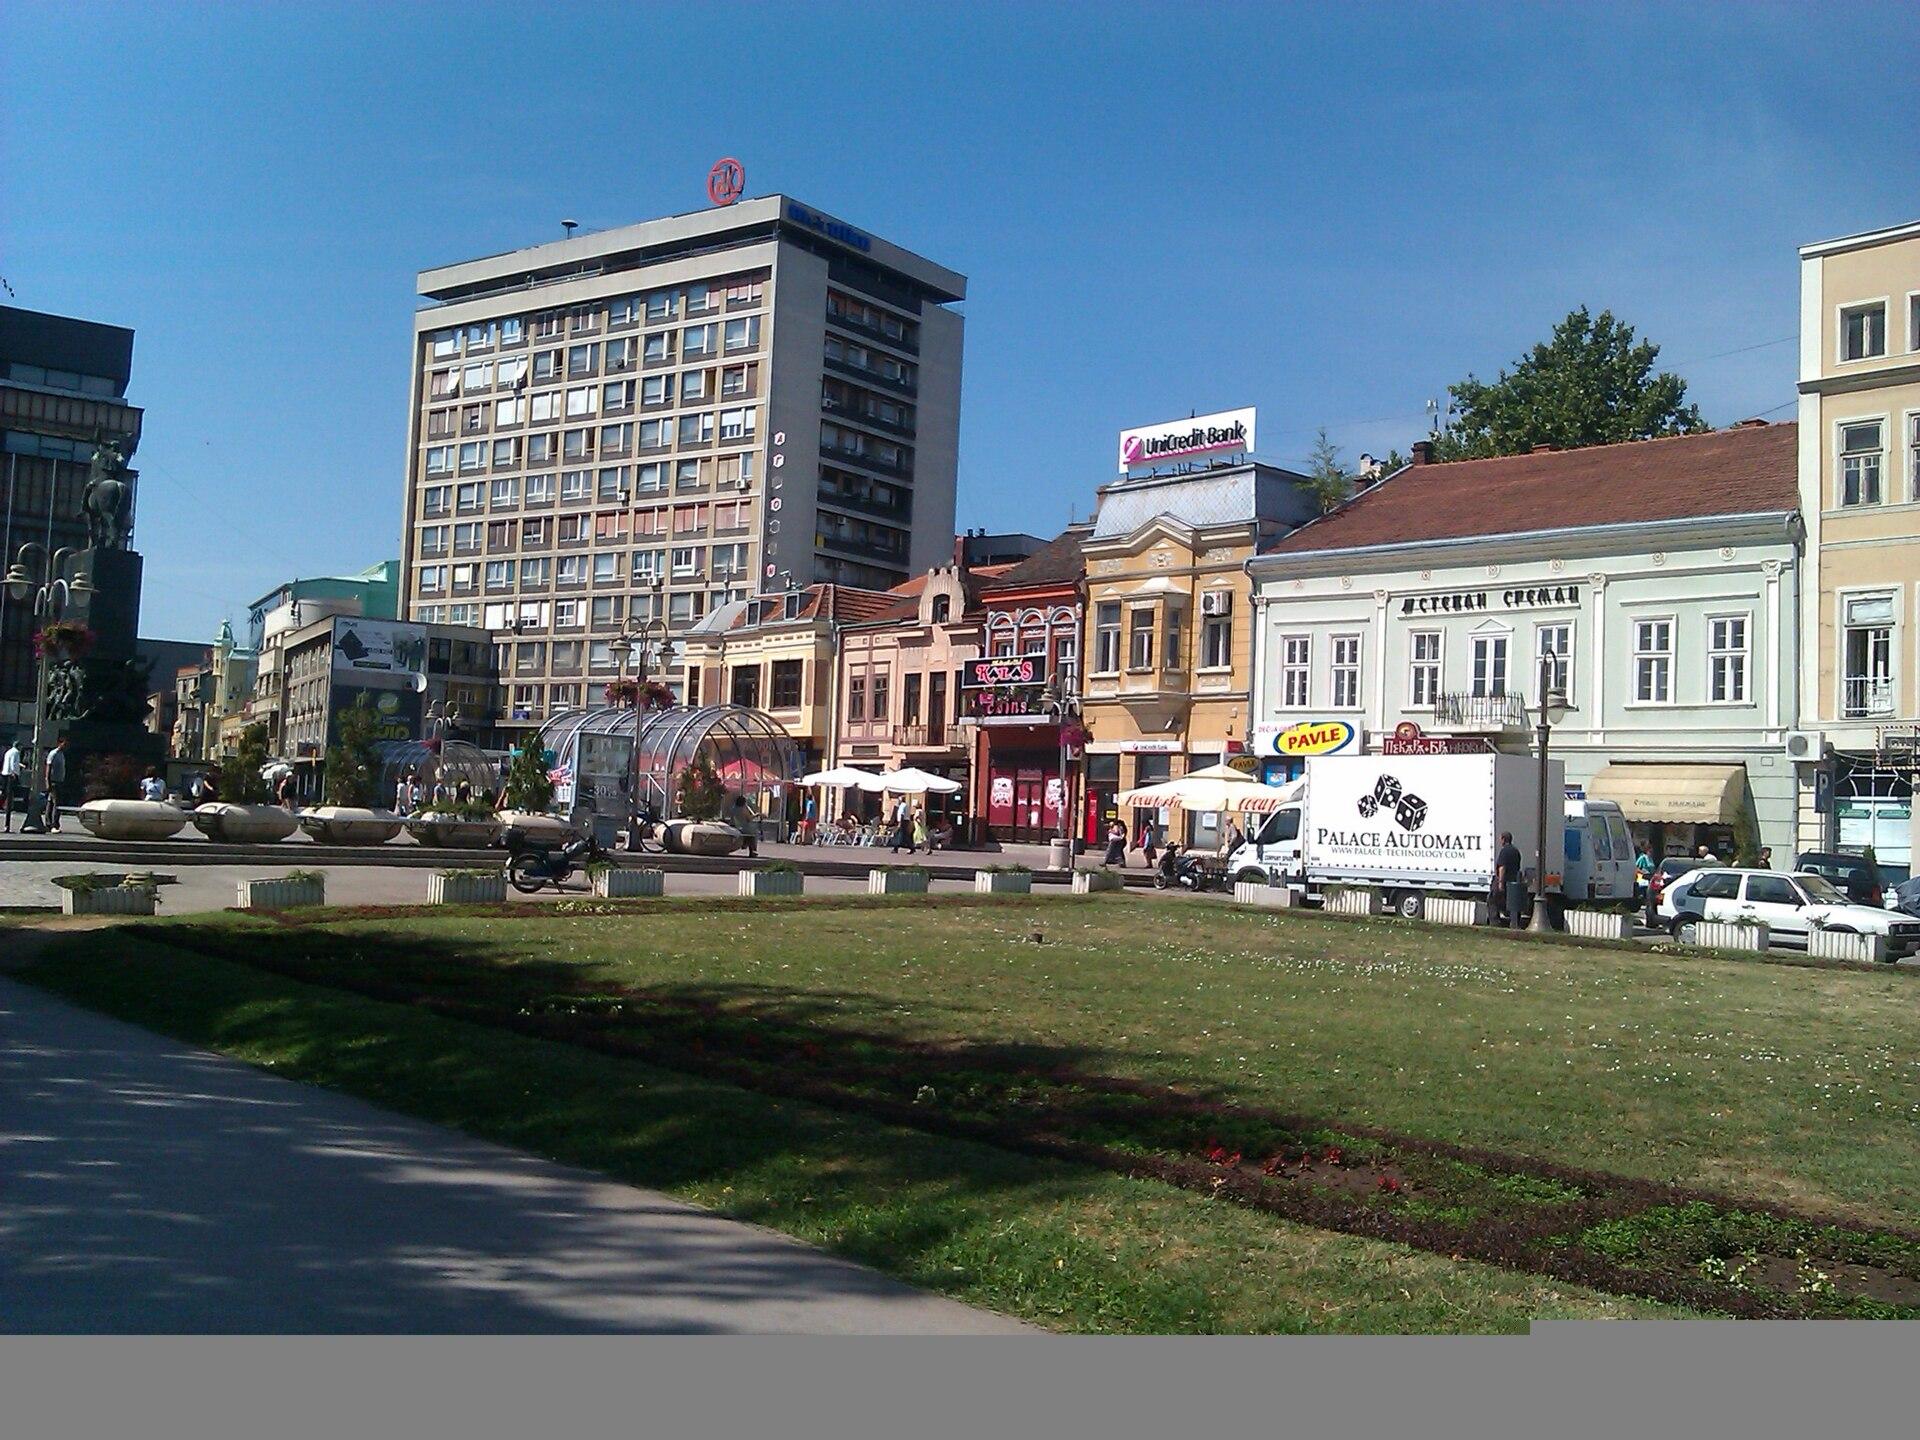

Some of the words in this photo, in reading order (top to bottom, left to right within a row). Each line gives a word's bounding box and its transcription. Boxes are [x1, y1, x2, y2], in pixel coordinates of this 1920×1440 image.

[1146, 426, 1206, 455] UniCredit
[1207, 420, 1247, 445] Bank
[1288, 728, 1340, 750] PAVLE
[1317, 828, 1380, 847] PALACE
[1384, 831, 1482, 850] AUTOMATI
